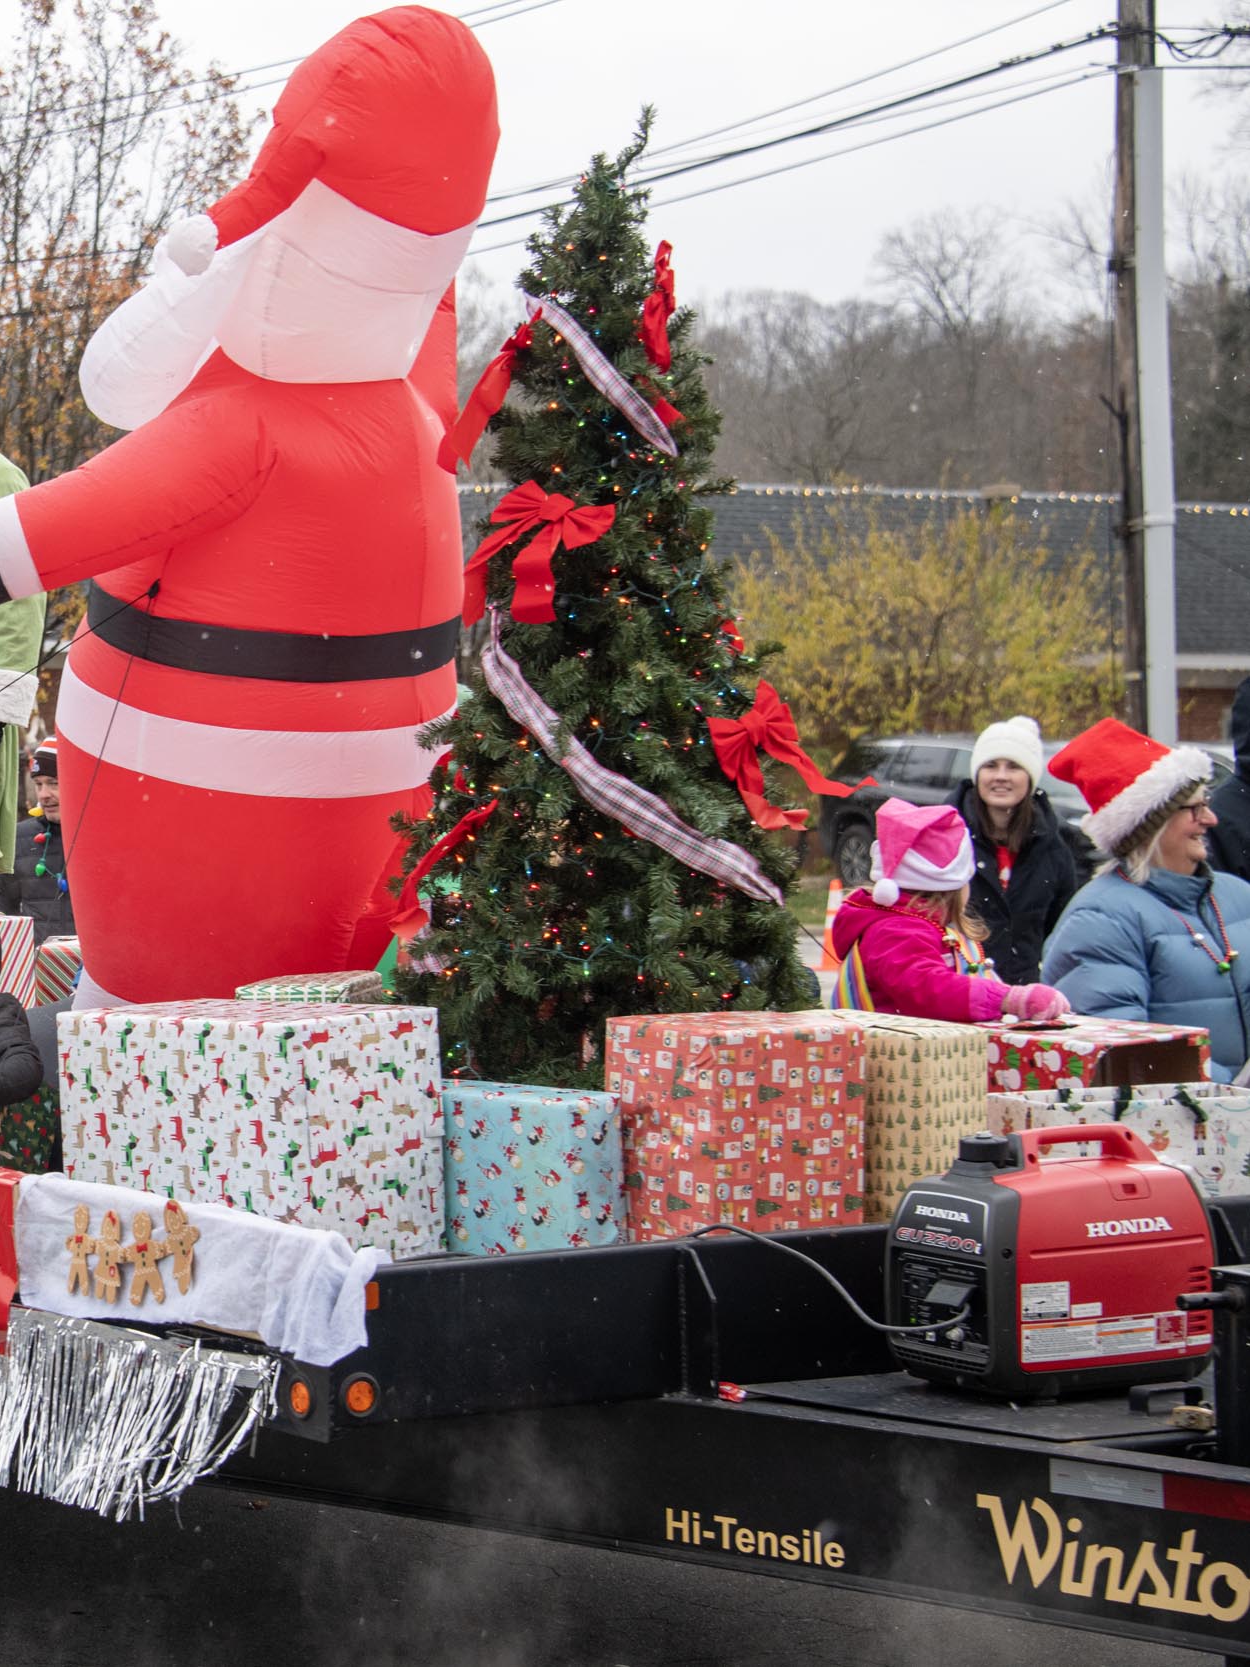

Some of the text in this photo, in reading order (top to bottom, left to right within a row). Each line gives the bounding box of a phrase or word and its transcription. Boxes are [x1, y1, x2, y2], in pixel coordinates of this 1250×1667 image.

[914, 1205, 971, 1223] HONDA
[1085, 1216, 1173, 1238] HONDA
[896, 1226, 982, 1255] EU2200i
[665, 1507, 846, 1568] Hi-Tensile
[976, 1493, 1250, 1622] Winsto
